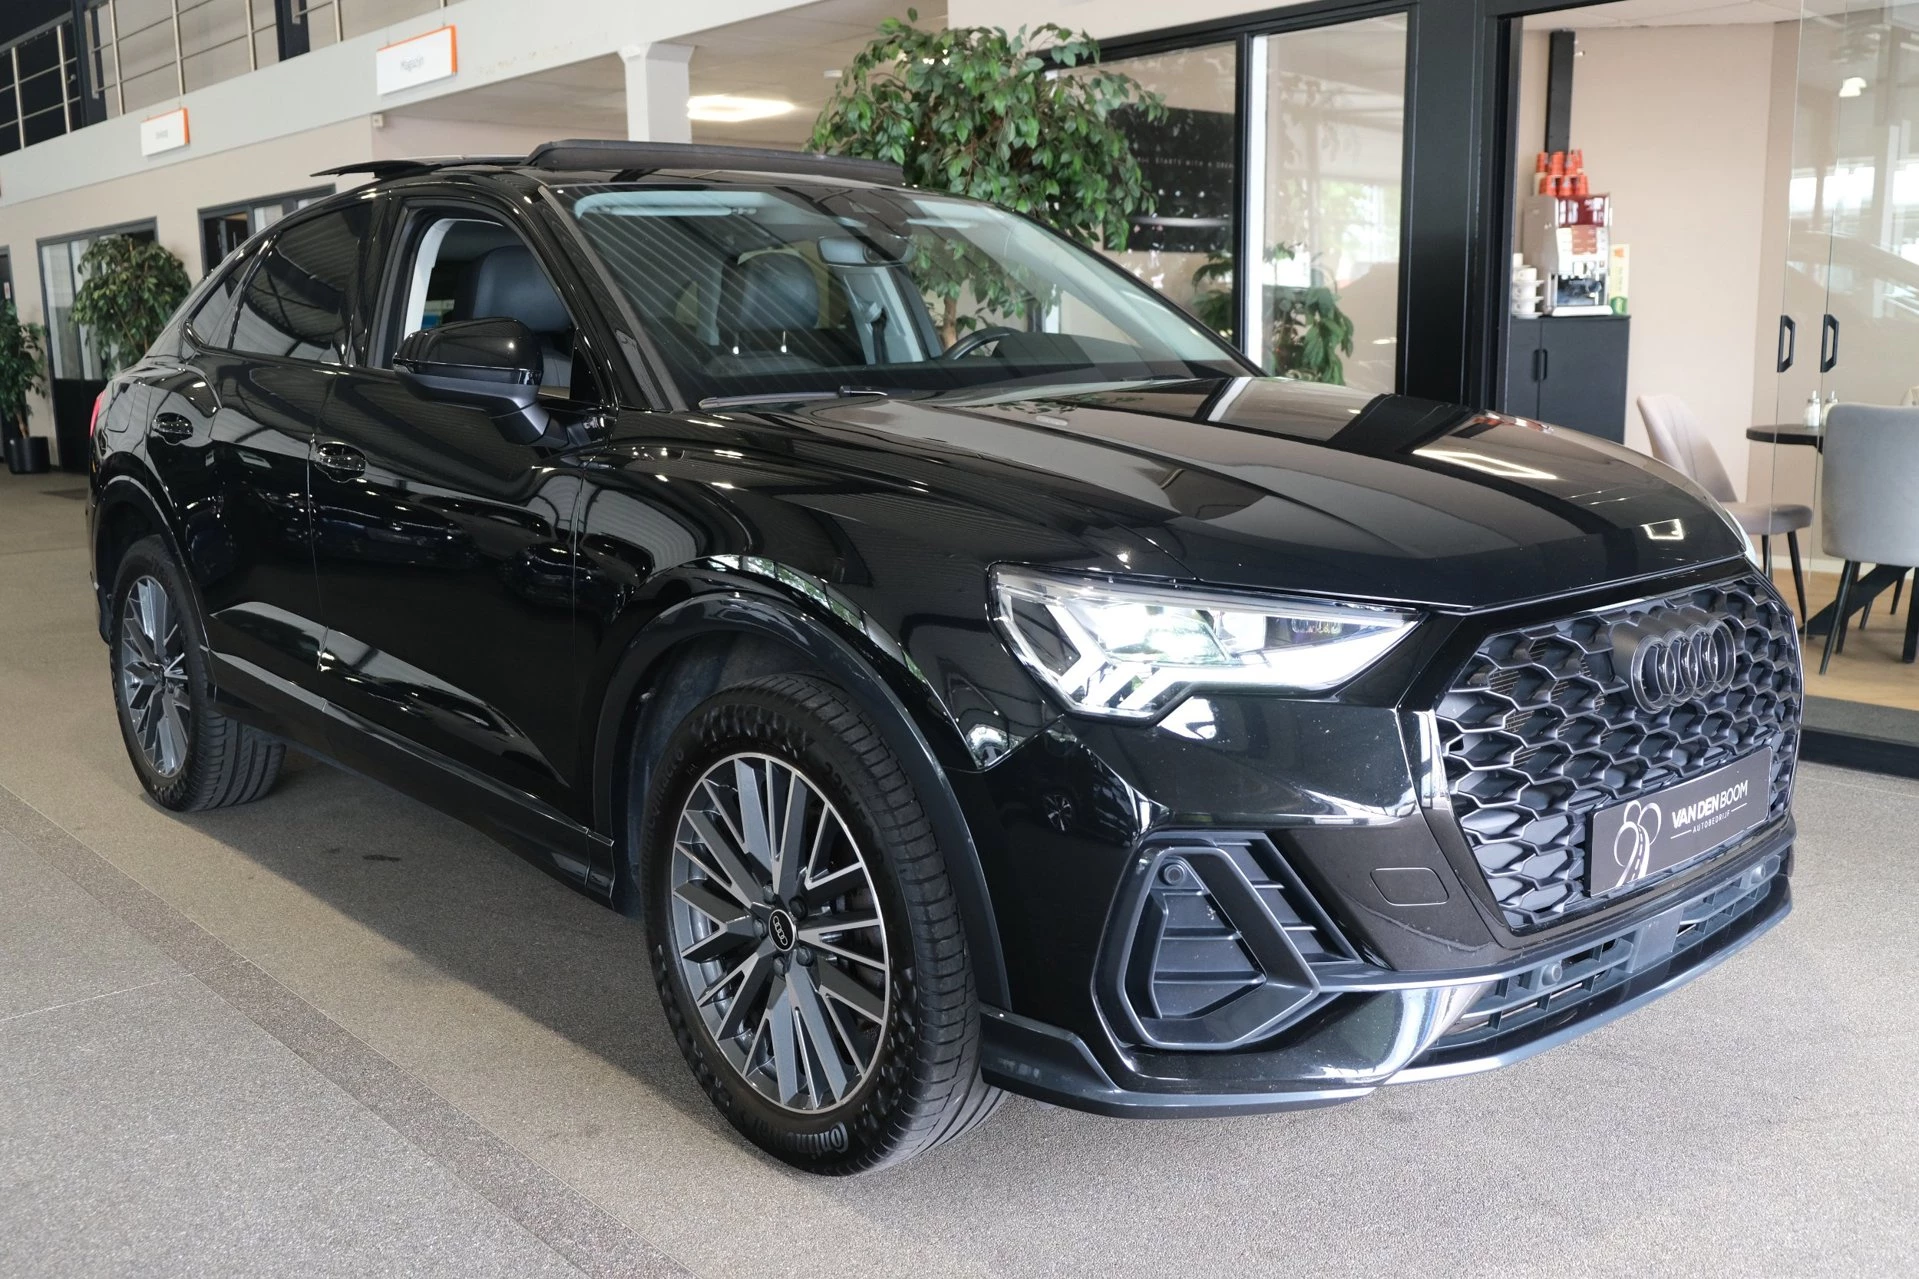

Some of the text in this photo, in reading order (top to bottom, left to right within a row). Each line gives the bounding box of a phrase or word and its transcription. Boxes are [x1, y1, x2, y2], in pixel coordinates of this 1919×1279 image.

[1216, 161, 1235, 169] DREA
[1672, 780, 1748, 829] VAN DEN BOOM
[1692, 809, 1730, 833] AUTOBEDRIJF
